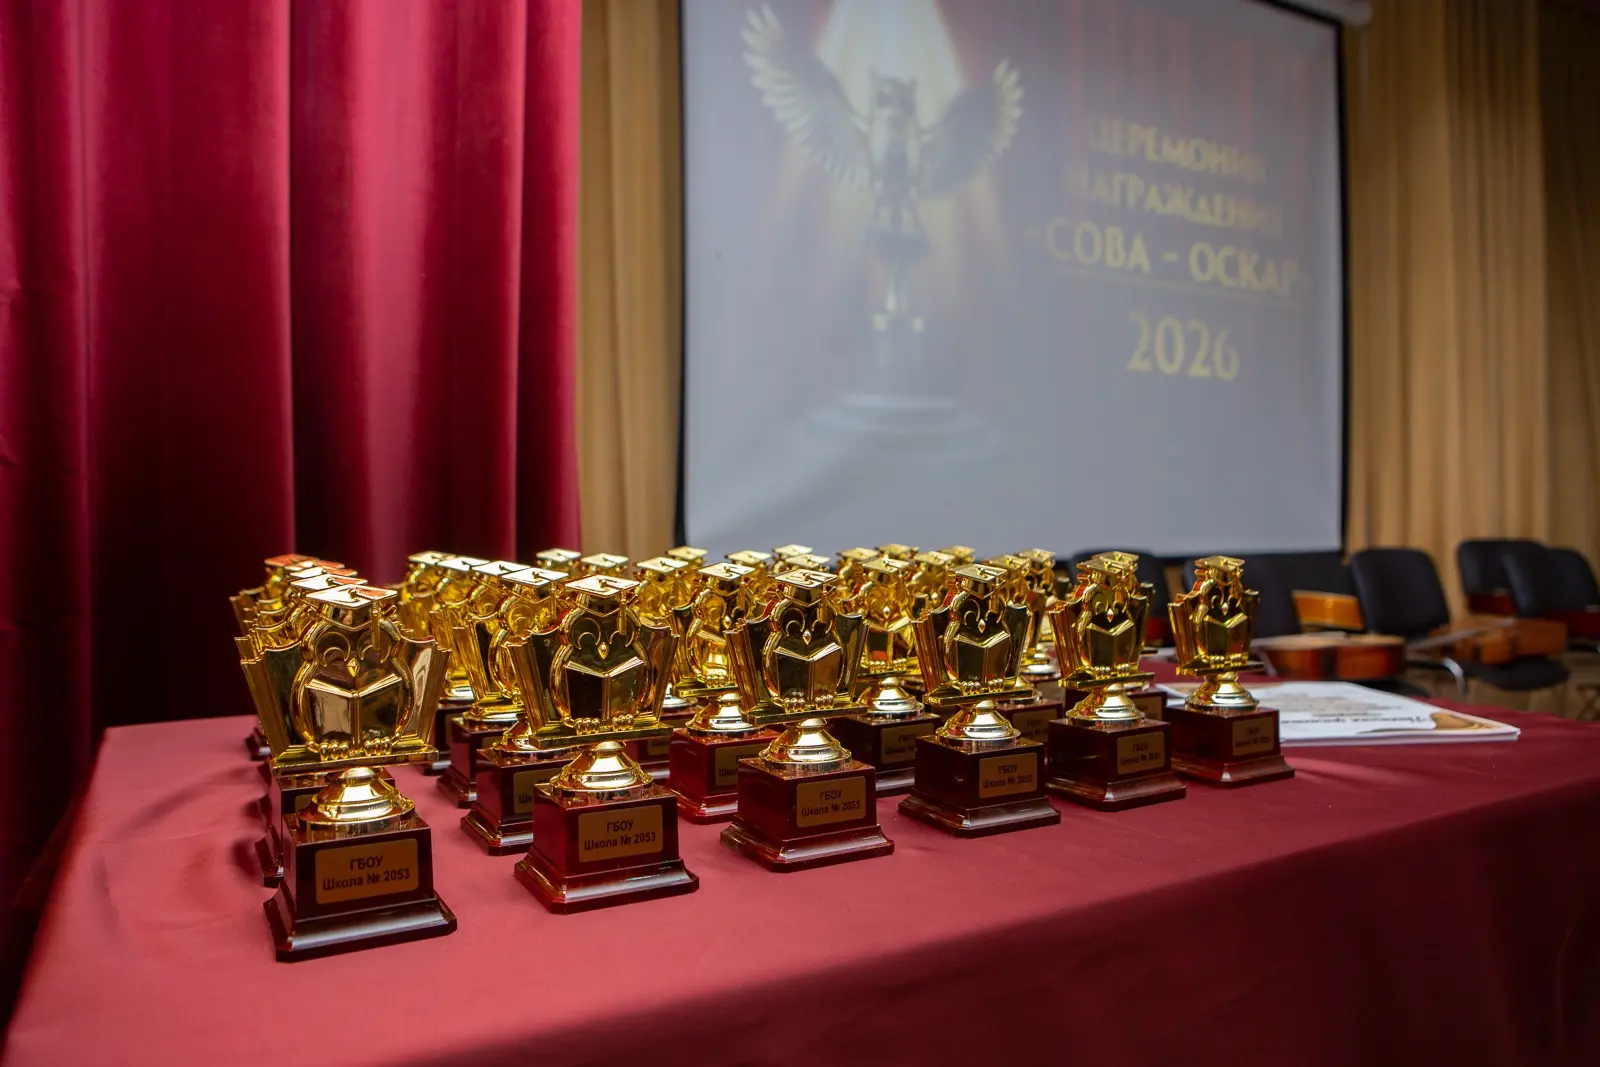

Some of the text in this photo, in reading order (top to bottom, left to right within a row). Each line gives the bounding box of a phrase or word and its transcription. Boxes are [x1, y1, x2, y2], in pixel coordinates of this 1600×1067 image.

[1126, 310, 1240, 381] 2026
[997, 763, 1018, 774] ГБОУ
[820, 788, 843, 802] ГБОУ
[801, 799, 861, 818] Школа № 2053
[606, 819, 634, 834] ГБОУ
[584, 832, 656, 851] Школа № 2053
[350, 854, 383, 871] ГБОУ
[322, 868, 410, 890] Школа № 2053
